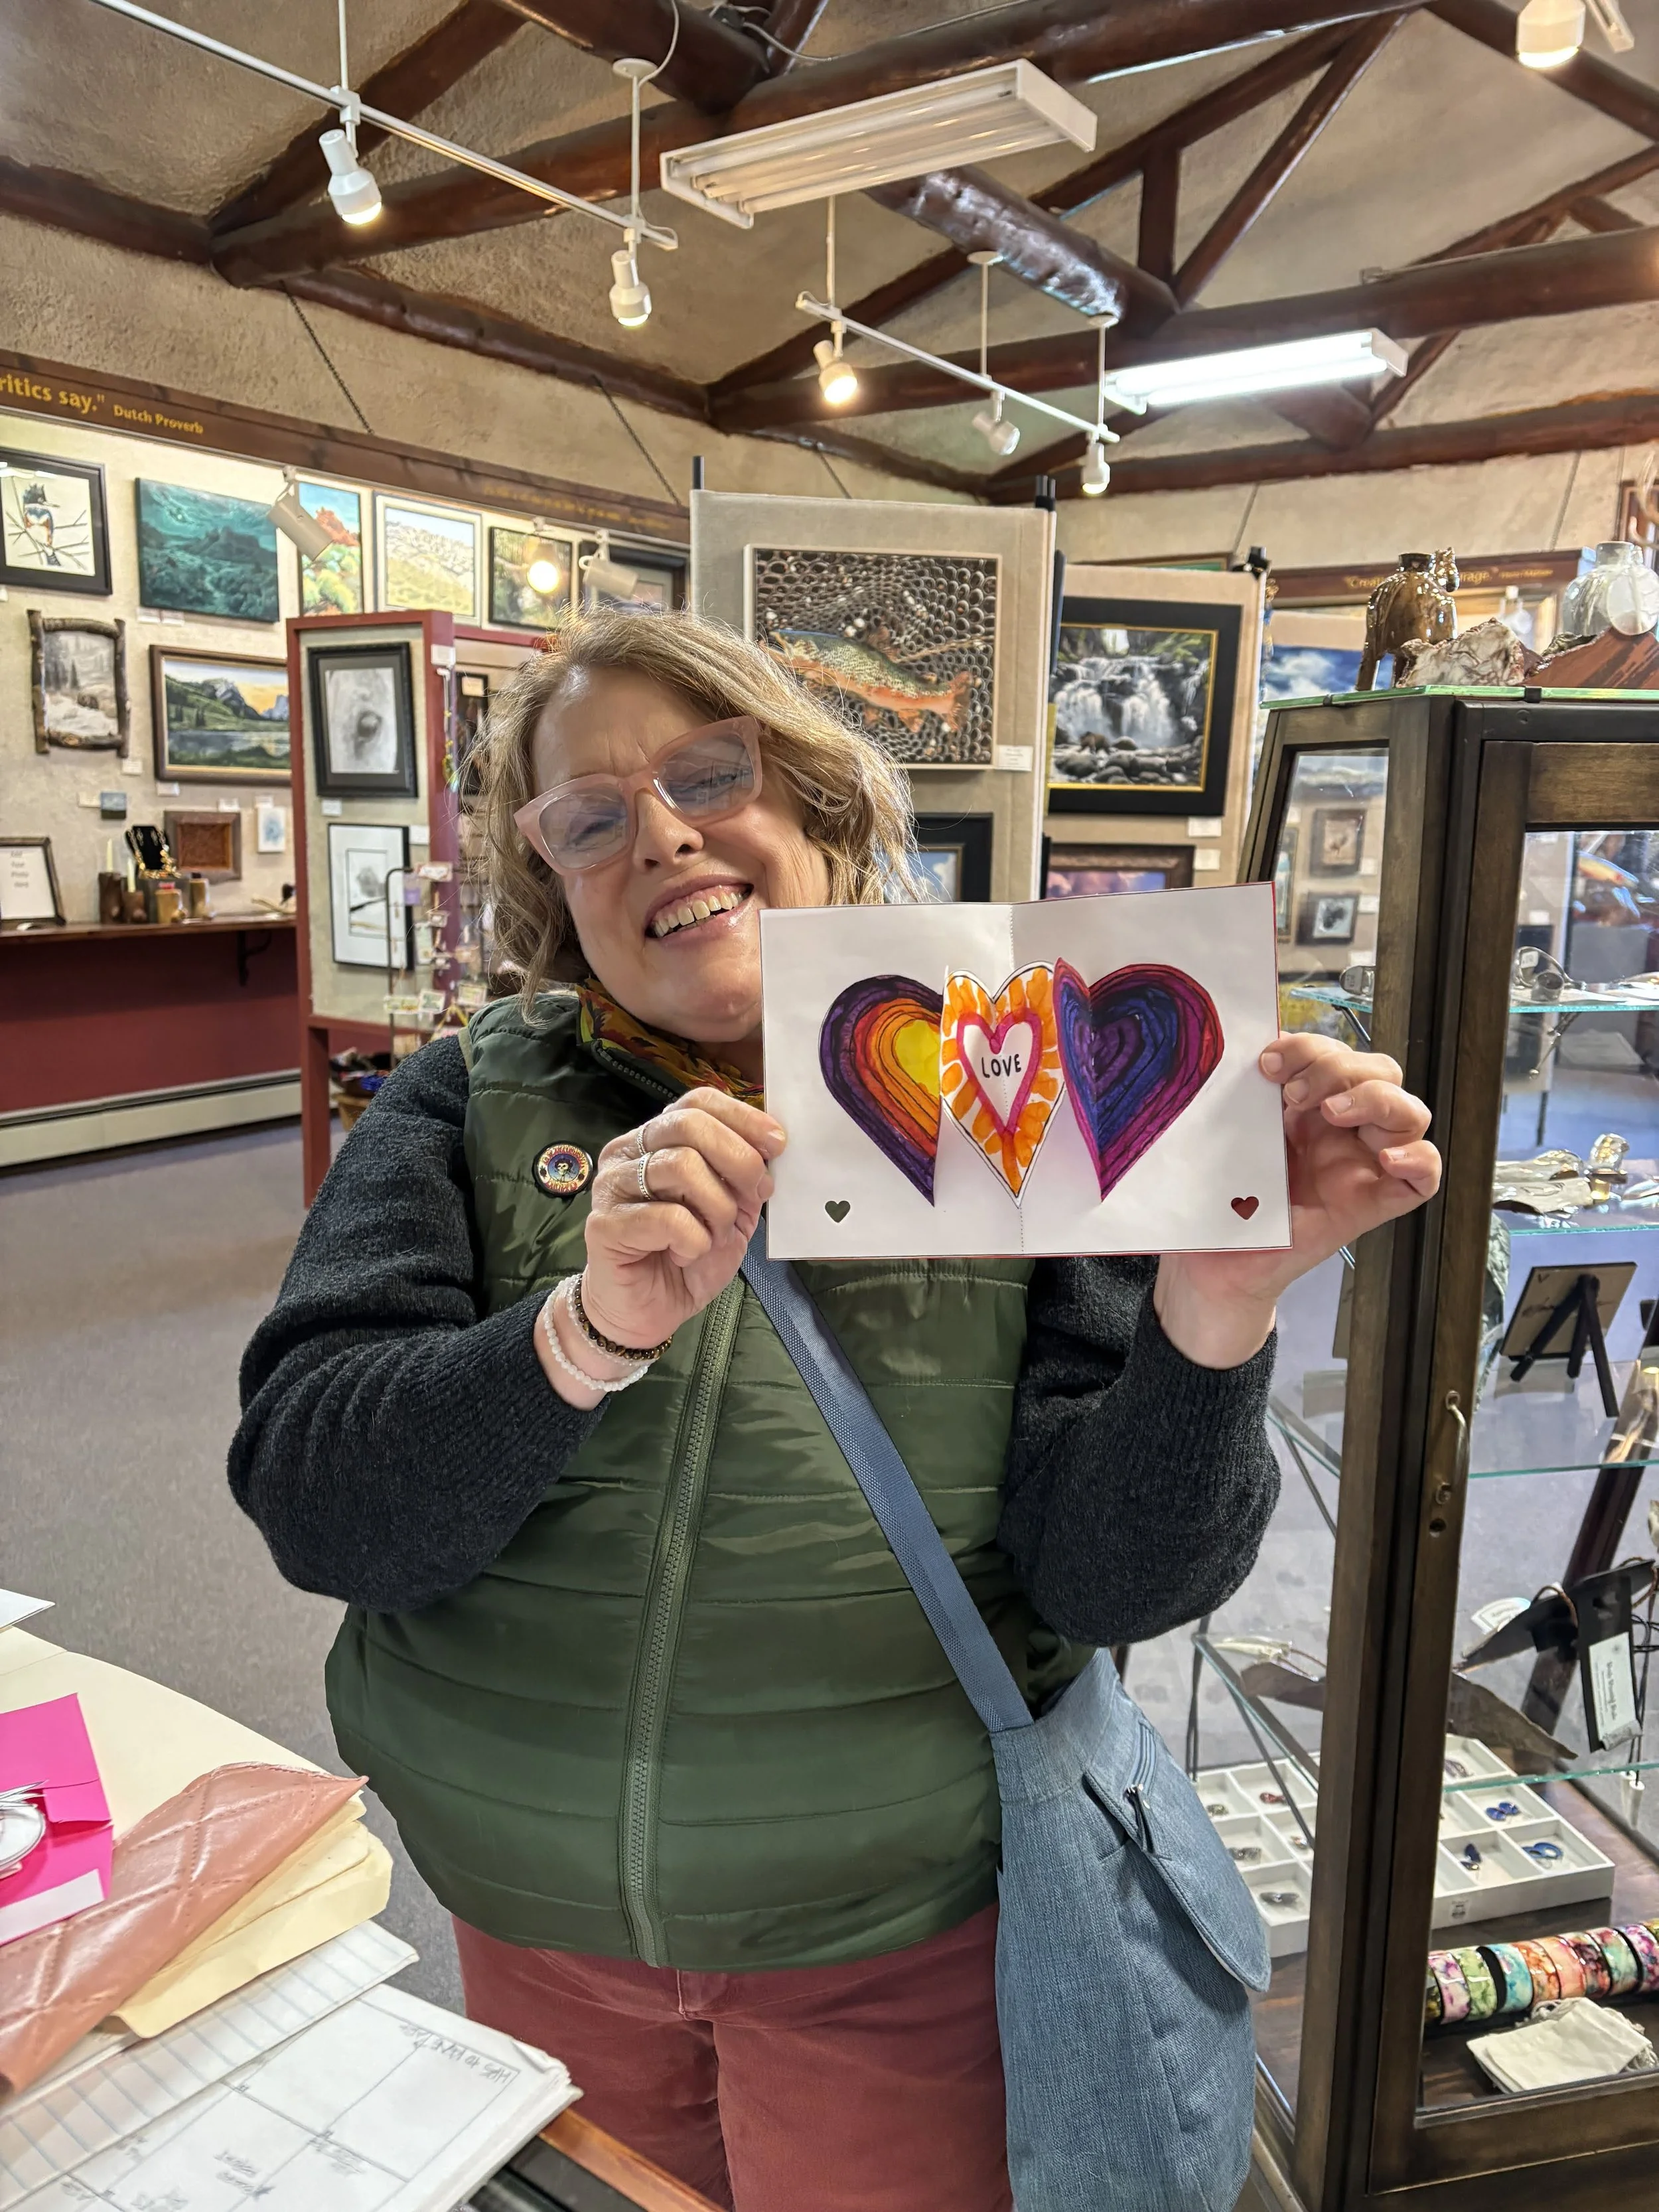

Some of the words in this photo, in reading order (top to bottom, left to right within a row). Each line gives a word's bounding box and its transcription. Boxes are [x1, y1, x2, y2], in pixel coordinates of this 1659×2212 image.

[58, 388, 105, 414] say."
[113, 404, 153, 424] Dutch
[154, 413, 204, 435] Proverb
[981, 1053, 1022, 1078] LOVE
